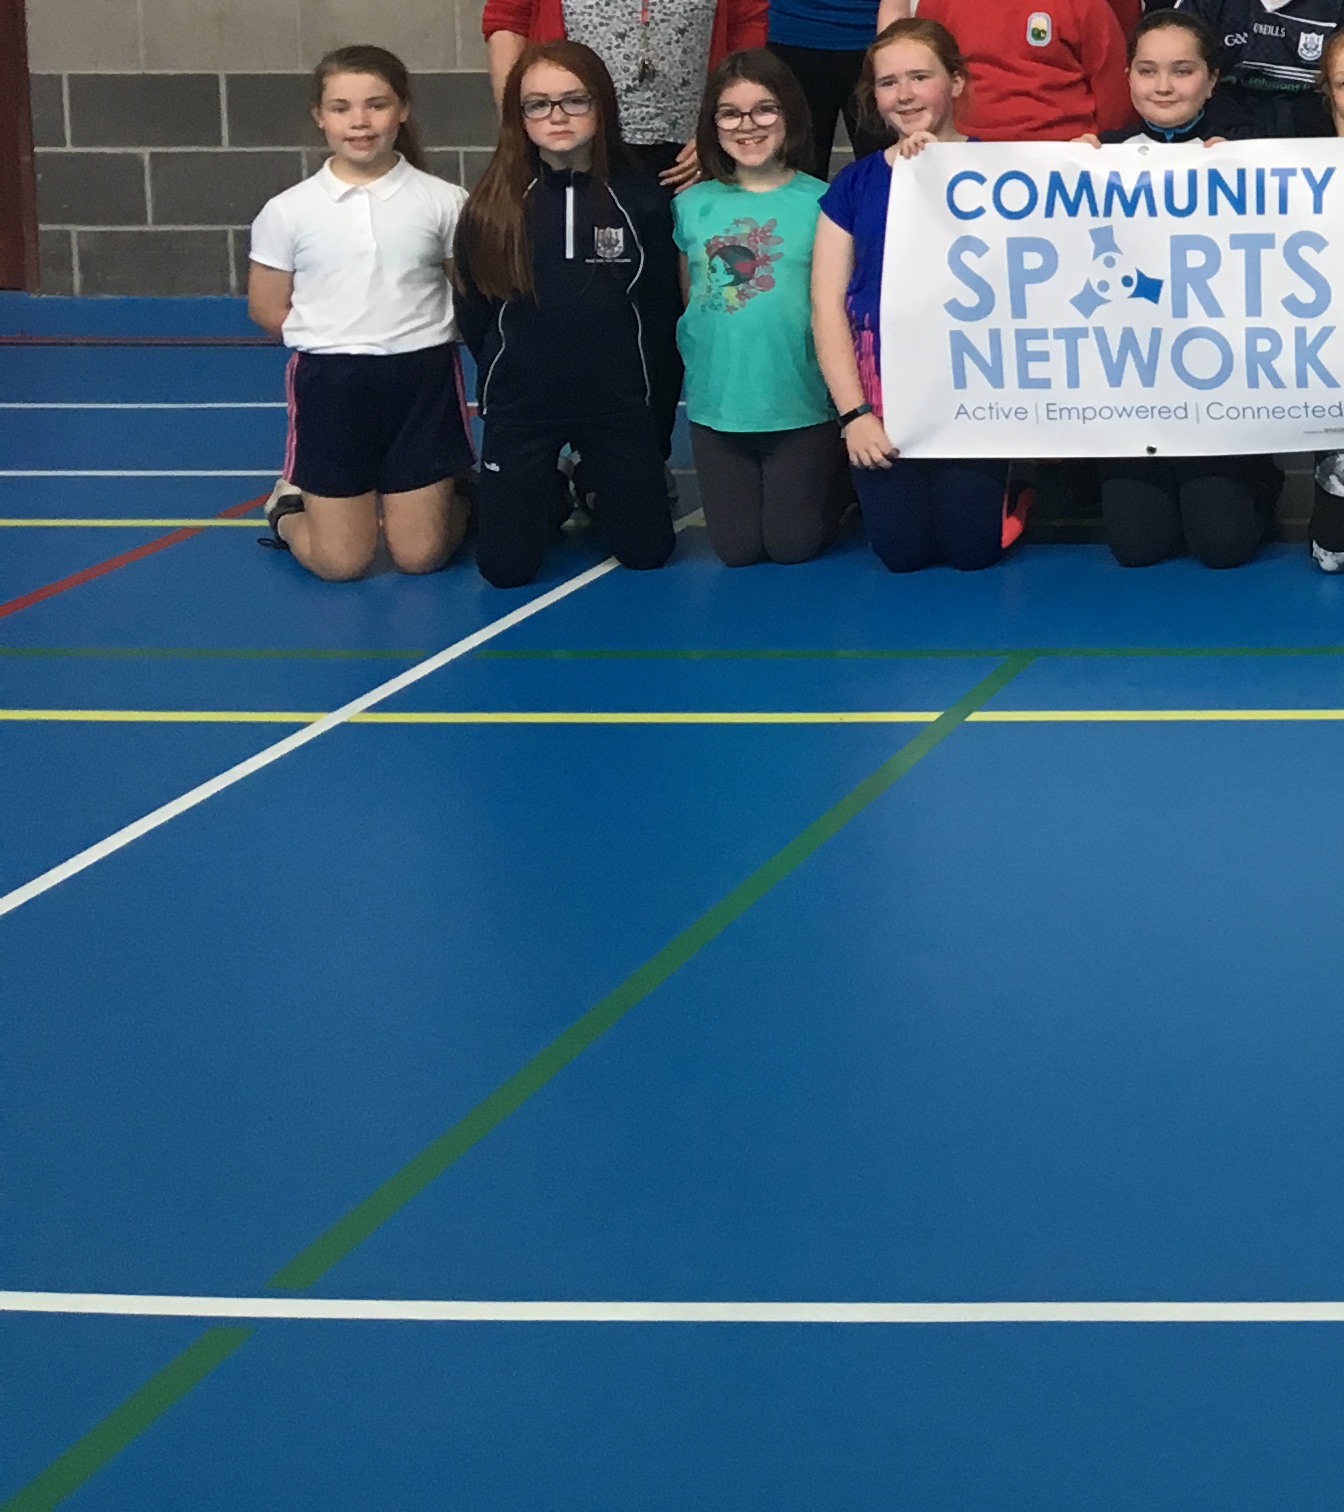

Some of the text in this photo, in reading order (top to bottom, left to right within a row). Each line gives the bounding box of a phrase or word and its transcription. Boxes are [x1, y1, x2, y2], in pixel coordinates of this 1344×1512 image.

[946, 167, 1336, 220] COMMUNITY
[948, 326, 1341, 390] NETWORK
[954, 401, 1343, 424] Active Empowered Connected
